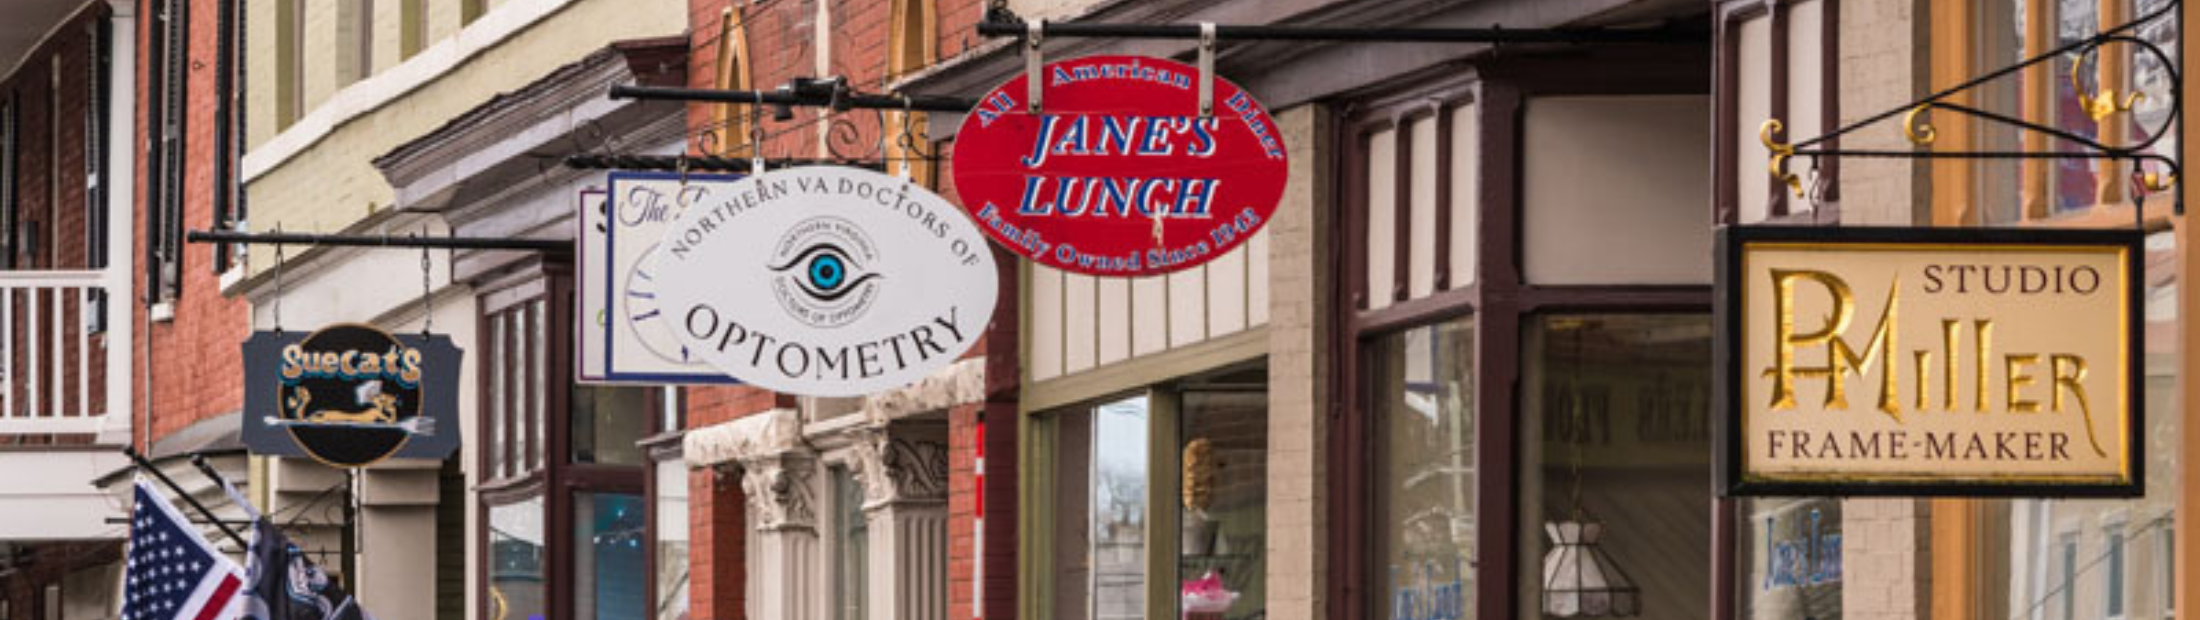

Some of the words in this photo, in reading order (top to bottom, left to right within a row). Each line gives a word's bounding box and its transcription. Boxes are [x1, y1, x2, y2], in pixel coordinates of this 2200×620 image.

[977, 91, 1017, 128] All
[1051, 59, 1190, 90] American
[1224, 89, 1285, 161] Diner
[1021, 114, 1220, 169] JANE'S
[618, 185, 670, 227] The
[671, 181, 788, 261] NORTHERN
[797, 177, 830, 195] VA
[838, 177, 951, 239] DOCTORS
[950, 238, 981, 268] OF
[1016, 175, 1221, 218] LUNCH
[976, 202, 1051, 257] Family
[1055, 243, 1142, 271] Owned
[1147, 240, 1211, 270] Since
[1923, 264, 2101, 295] STUDIO
[685, 303, 965, 381] OPTOMETRY
[1767, 430, 2072, 461] FRAME-MAKER
